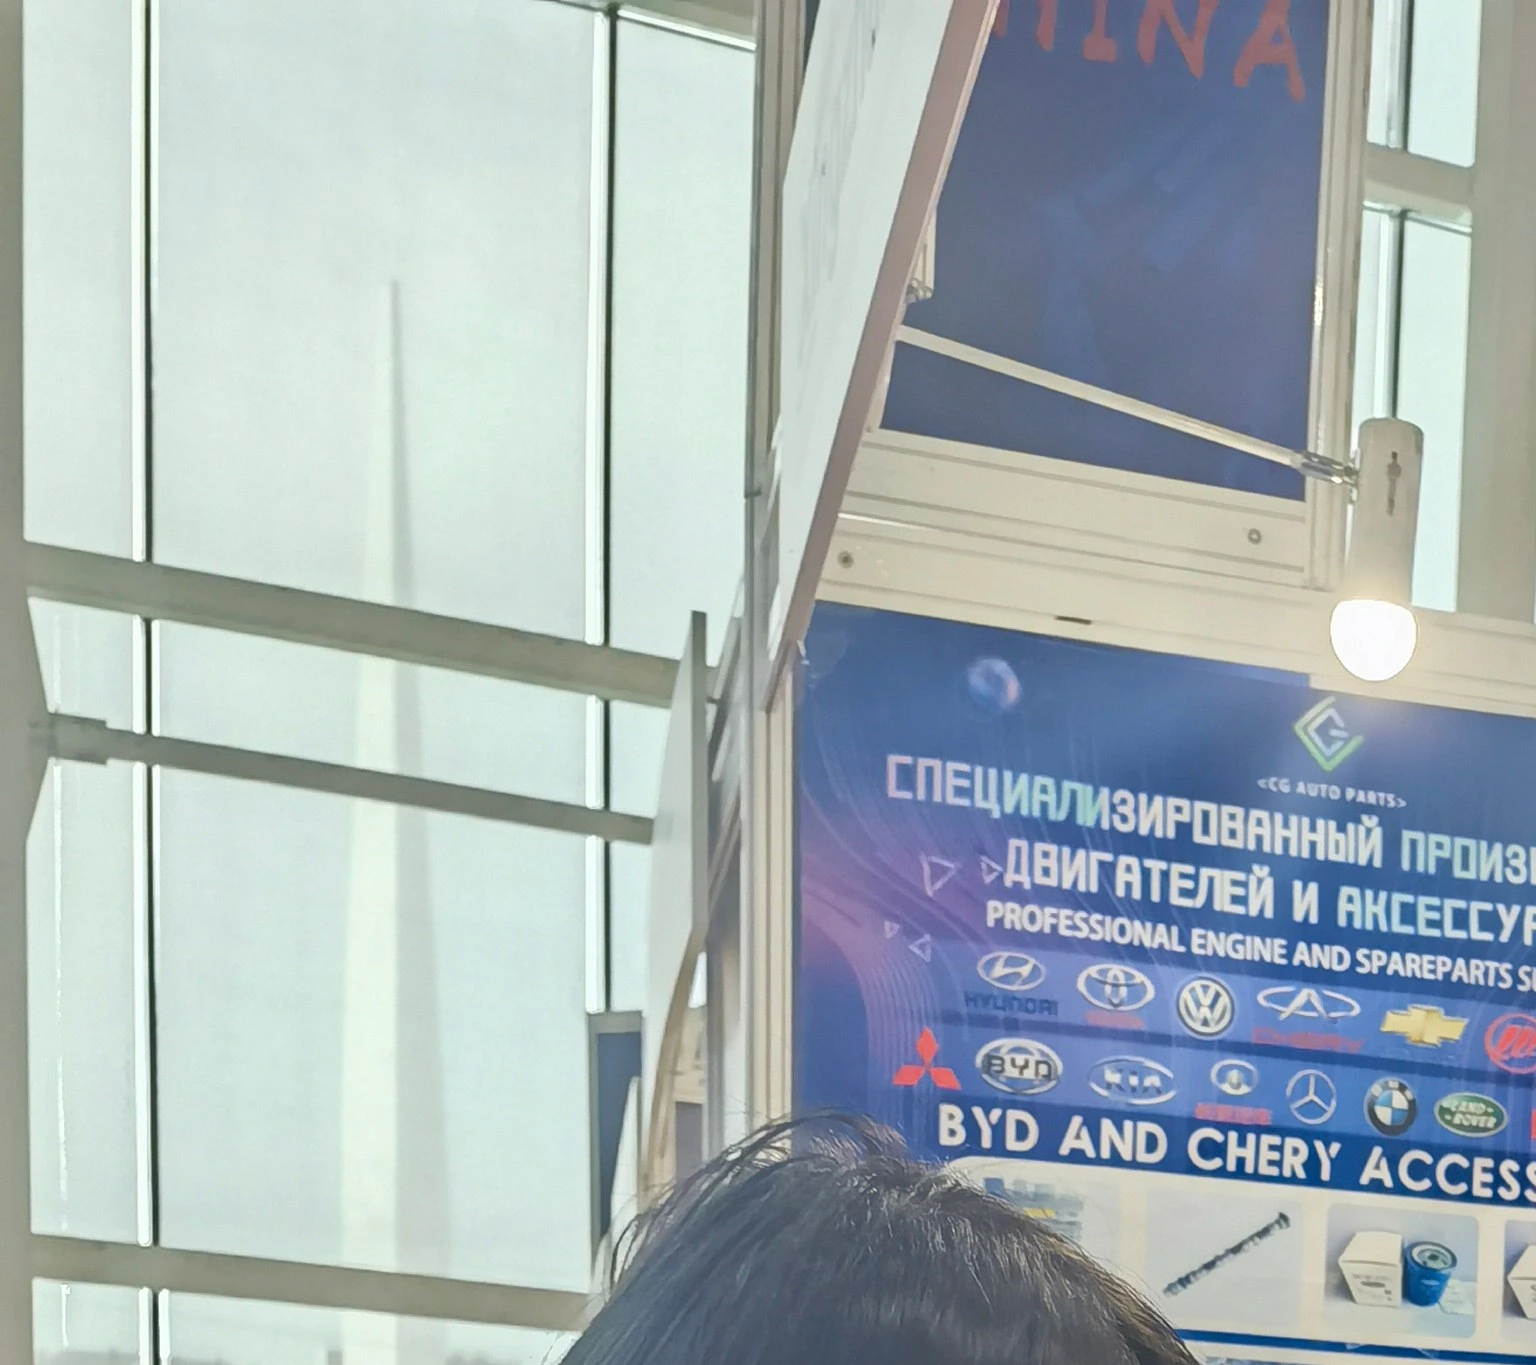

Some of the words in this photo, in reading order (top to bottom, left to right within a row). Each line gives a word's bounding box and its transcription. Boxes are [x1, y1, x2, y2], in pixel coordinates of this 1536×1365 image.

[886, 754, 1383, 868] СПЕЦИАЛИЗИРОВАННЫЙ
[1296, 781, 1341, 800] AUTO
[1004, 838, 1275, 919] ДВИГАТЕЛЕЙ
[1292, 879, 1319, 925] И
[987, 900, 1186, 954] PROFESSIONAL
[1191, 931, 1288, 966] ENGINE
[1293, 942, 1350, 973] AND
[1355, 948, 1512, 989] SPAREPARTS
[988, 1054, 1052, 1079] BYD
[938, 1102, 1039, 1152] BYD
[1059, 1115, 1168, 1163] AND
[1188, 1127, 1340, 1181] CHERY
